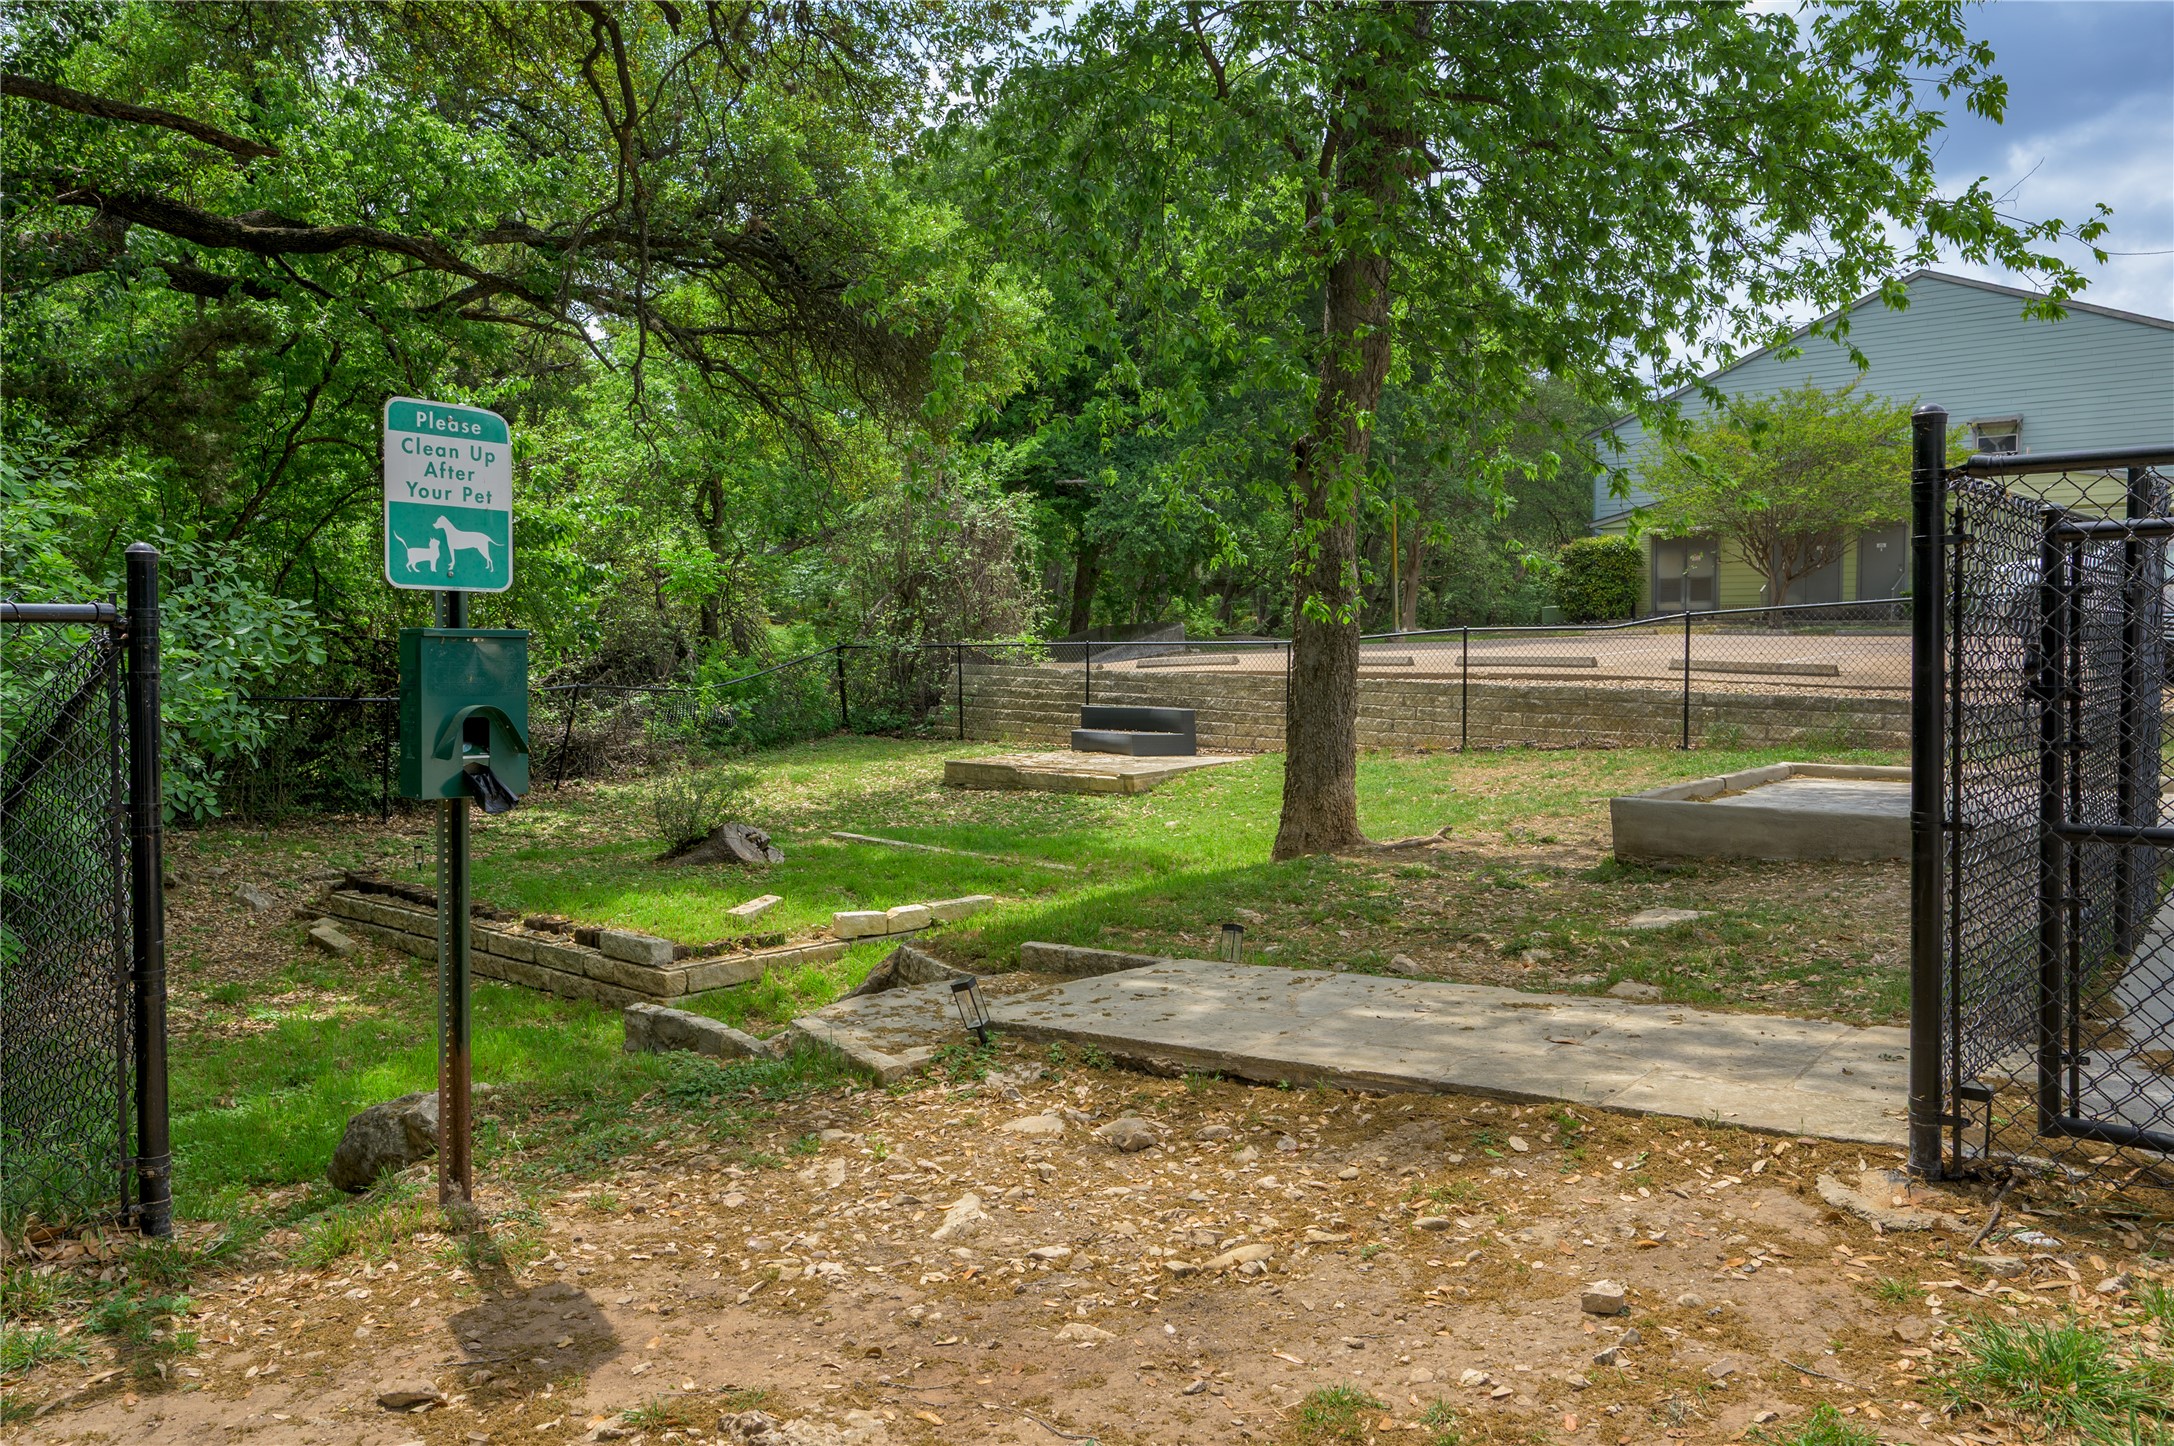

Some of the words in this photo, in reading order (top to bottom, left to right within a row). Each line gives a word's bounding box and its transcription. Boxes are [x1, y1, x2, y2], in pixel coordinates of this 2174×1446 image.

[416, 411, 481, 435] Please
[401, 437, 460, 459] Clean
[470, 445, 496, 467] Up
[424, 461, 475, 482] After
[406, 481, 452, 500] Your
[463, 487, 492, 504] Pet
